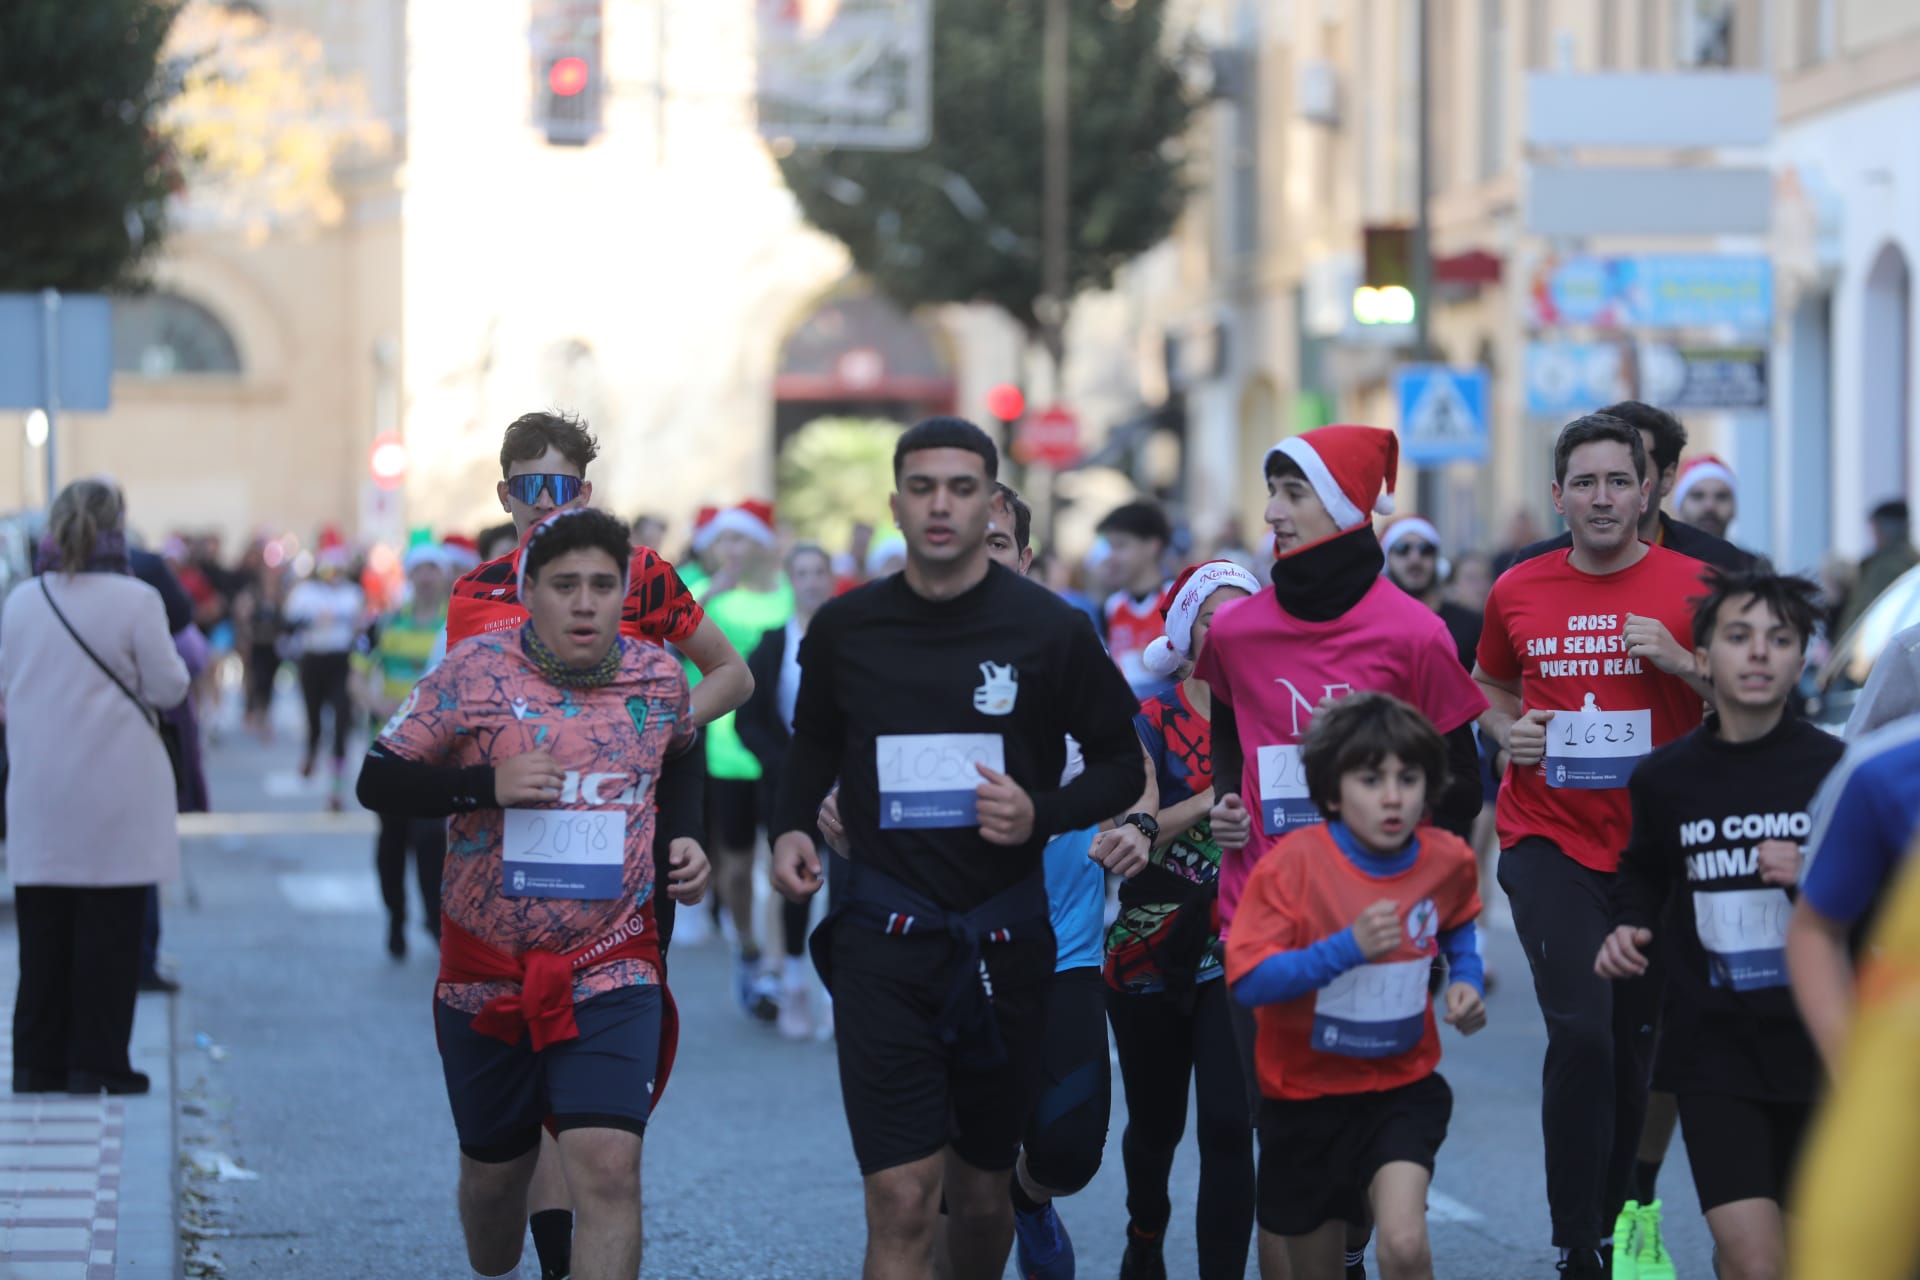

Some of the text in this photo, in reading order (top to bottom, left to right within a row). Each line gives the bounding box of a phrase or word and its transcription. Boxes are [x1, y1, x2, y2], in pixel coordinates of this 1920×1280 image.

[1568, 614, 1617, 631] CROSS
[1527, 637, 1558, 656] SAN
[1540, 657, 1643, 678] PUERTO REAL
[1565, 723, 1635, 745] 1623
[522, 814, 609, 858] 2098
[1680, 812, 1811, 847] NO COMO
